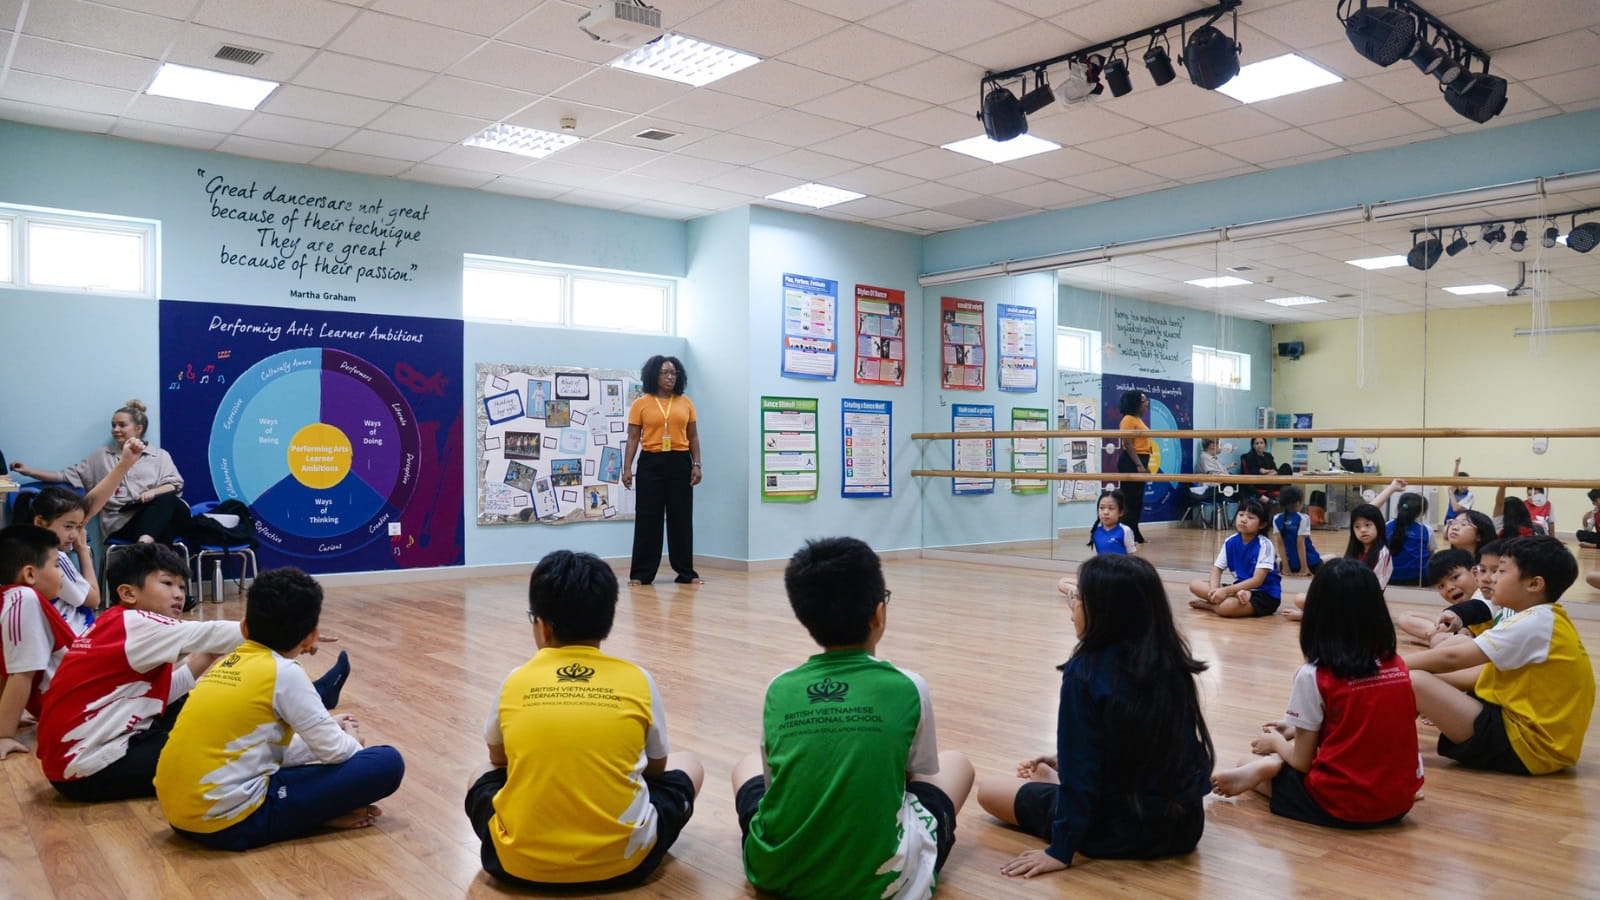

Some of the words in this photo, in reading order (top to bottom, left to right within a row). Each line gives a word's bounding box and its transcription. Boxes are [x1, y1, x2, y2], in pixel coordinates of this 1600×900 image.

[360, 198, 384, 215] not
[385, 204, 430, 226] great
[211, 198, 275, 224] because
[282, 208, 299, 233] of
[304, 211, 344, 232] their
[348, 216, 421, 248] technique
[257, 228, 301, 259] They
[306, 241, 334, 252] are
[334, 240, 387, 264] great
[220, 244, 286, 270] because
[292, 253, 308, 280] of
[314, 256, 352, 276] their
[290, 290, 320, 300] Martha
[323, 292, 357, 302] Graham
[208, 316, 281, 342] Performing
[286, 320, 314, 337] Arts
[320, 322, 365, 340] Learner
[369, 326, 424, 344] Ambitions
[260, 361, 292, 380] Culturally
[292, 359, 312, 369] Aware
[340, 361, 373, 382] Performers
[224, 399, 242, 430] Expressive
[258, 418, 278, 426] Ways
[364, 420, 382, 428] Ways
[258, 436, 280, 446] Being
[364, 437, 383, 446] Doing
[290, 446, 333, 454] Performing
[314, 498, 332, 506] Ways
[308, 516, 340, 524] Thinking
[369, 512, 390, 534] Creative
[254, 520, 283, 544] Reflective
[318, 544, 342, 552] Curious
[522, 692, 586, 700] INTERNATIONAL
[588, 694, 622, 702] SCHOOL
[784, 710, 814, 720] BRITISH
[815, 706, 874, 715] VIETNAMESE
[778, 716, 844, 730] INTERNATIONAL
[845, 714, 882, 722] SCHOOL
